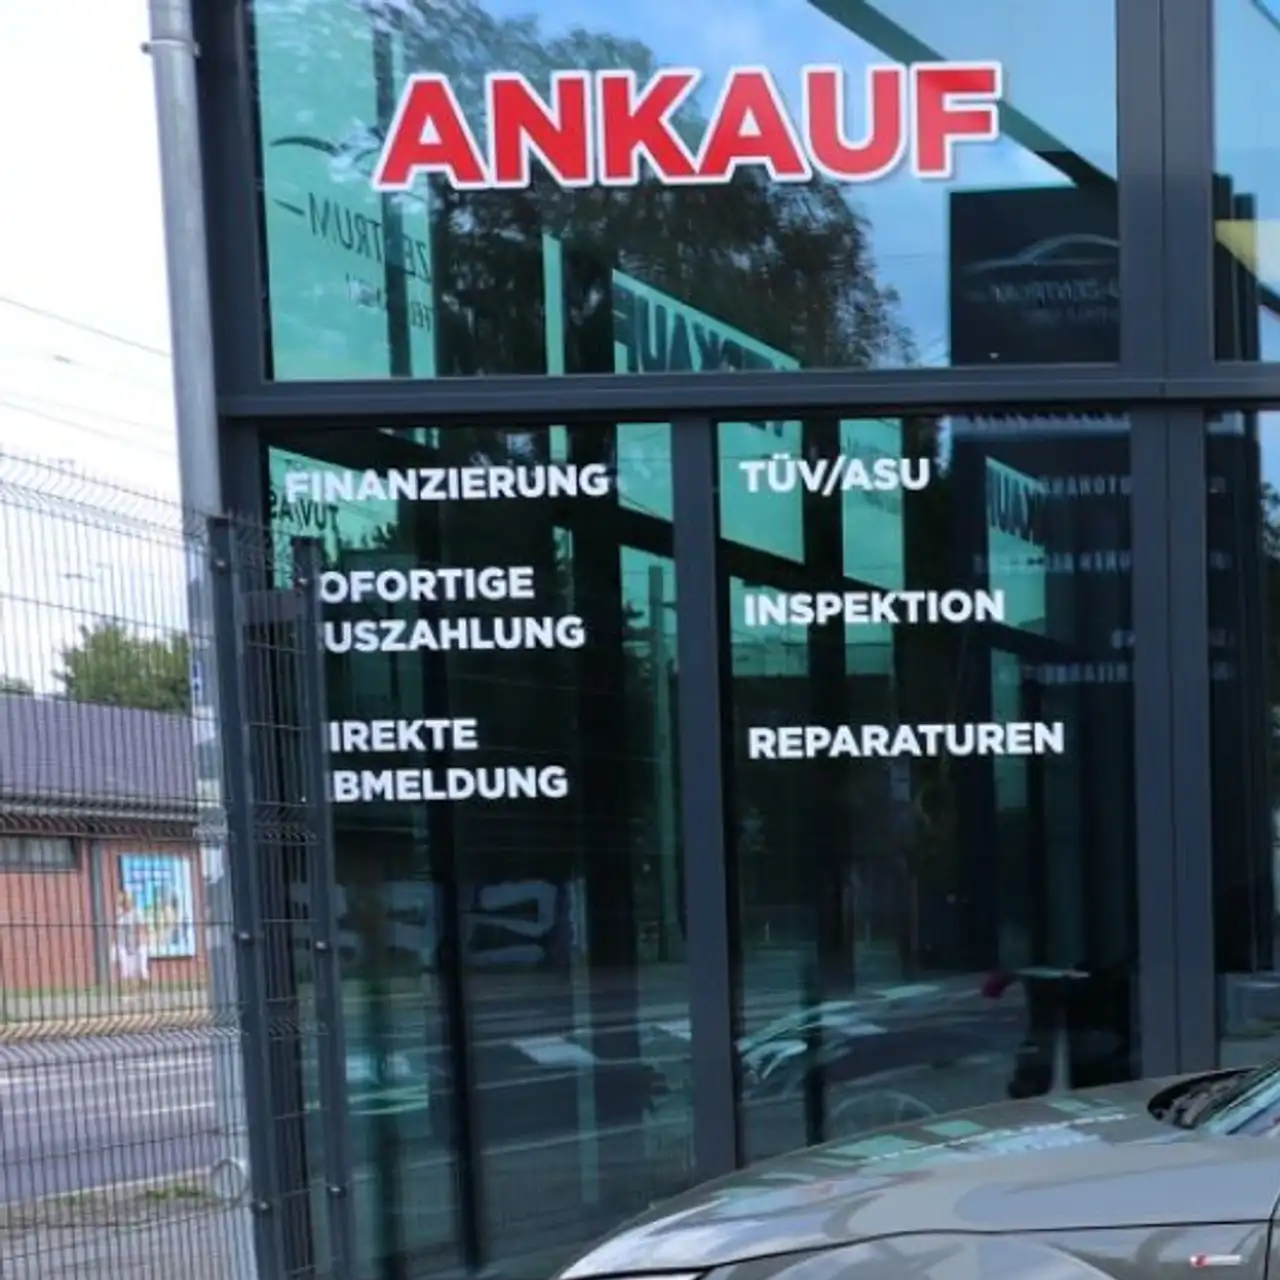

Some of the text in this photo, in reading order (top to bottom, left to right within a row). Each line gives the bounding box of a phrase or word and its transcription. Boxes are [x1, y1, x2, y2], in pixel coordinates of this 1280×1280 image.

[375, 62, 1003, 189] ANKAUF
[284, 463, 610, 504] FINANZIERUNG
[740, 453, 930, 497] TÜV/ASU
[320, 565, 536, 603] OFORTIGE
[744, 589, 1005, 627] INSPEKTION
[324, 614, 587, 654] USZAHLUNG
[329, 718, 479, 752] IREKTE
[748, 720, 1066, 760] REPARATUREN
[330, 765, 569, 803] BMELDUNG
